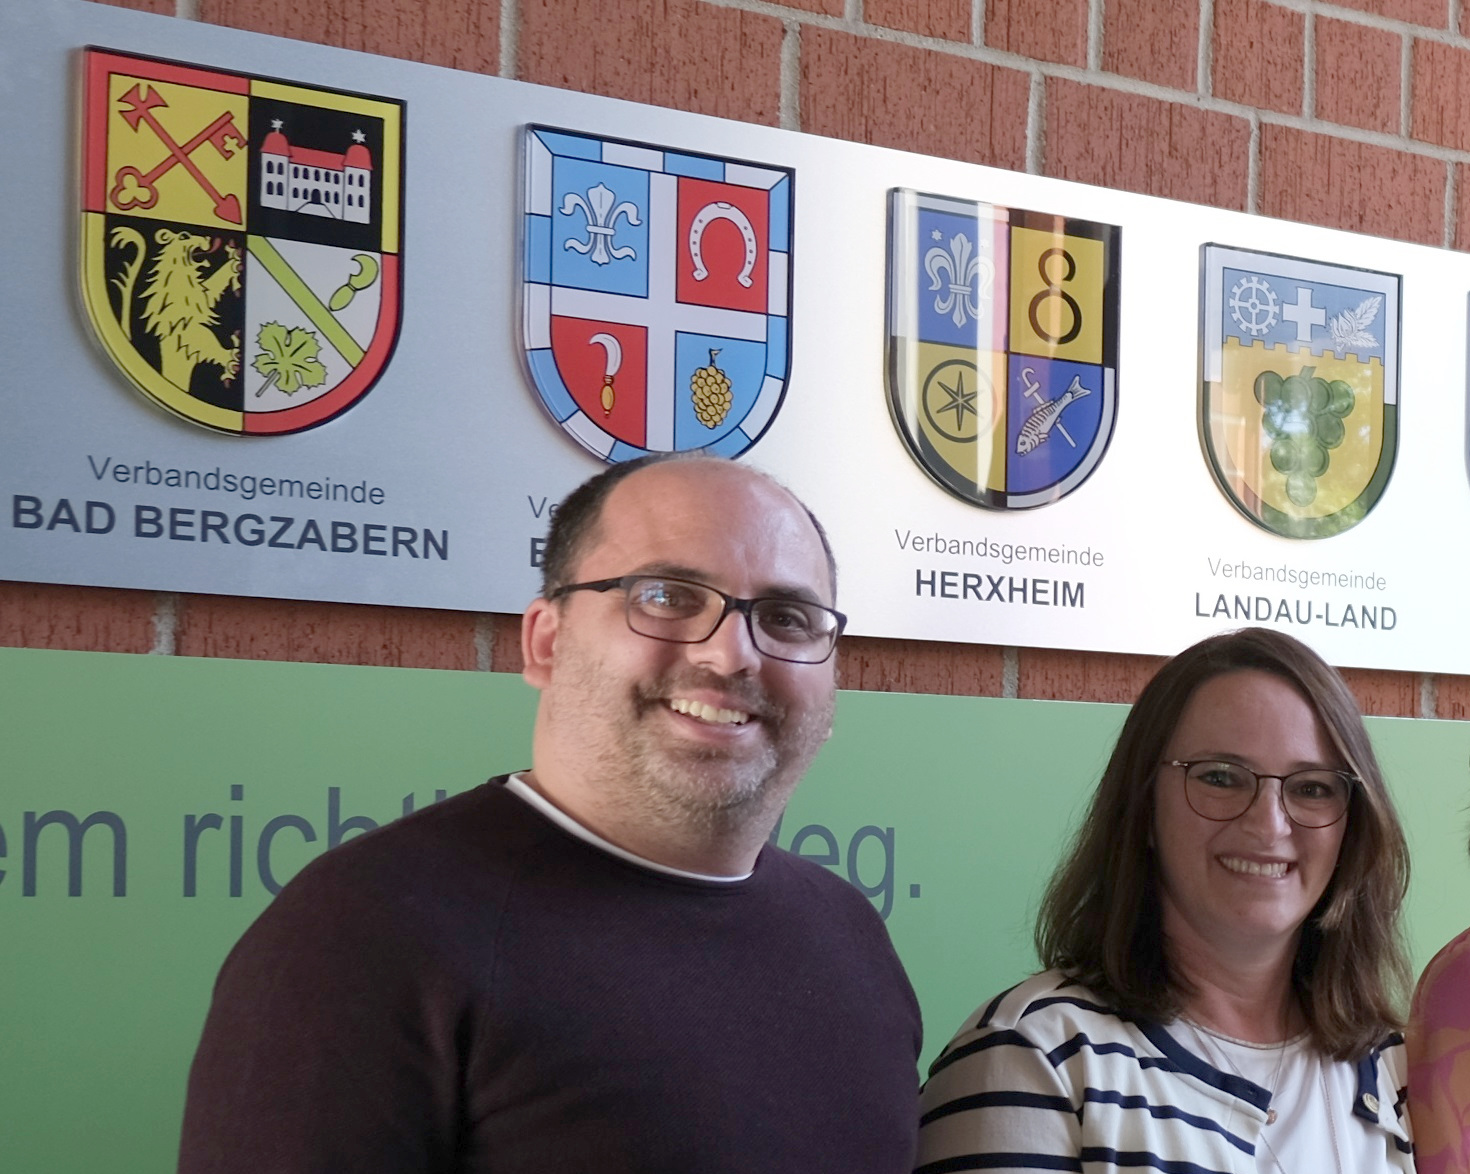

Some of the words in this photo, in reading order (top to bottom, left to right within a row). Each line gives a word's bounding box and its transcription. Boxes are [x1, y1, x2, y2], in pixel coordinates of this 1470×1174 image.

[88, 455, 385, 505] Verbandsgemeinde
[12, 494, 116, 535] BAD
[134, 504, 449, 560] BERGZABERN
[894, 529, 1105, 566] Verbandsgemeinde
[915, 569, 1085, 608] HERXHEIM
[1207, 557, 1386, 591] Verbandsgemeinde
[1195, 592, 1398, 630] LANDAU-LAND
[769, 811, 921, 922] eg.
